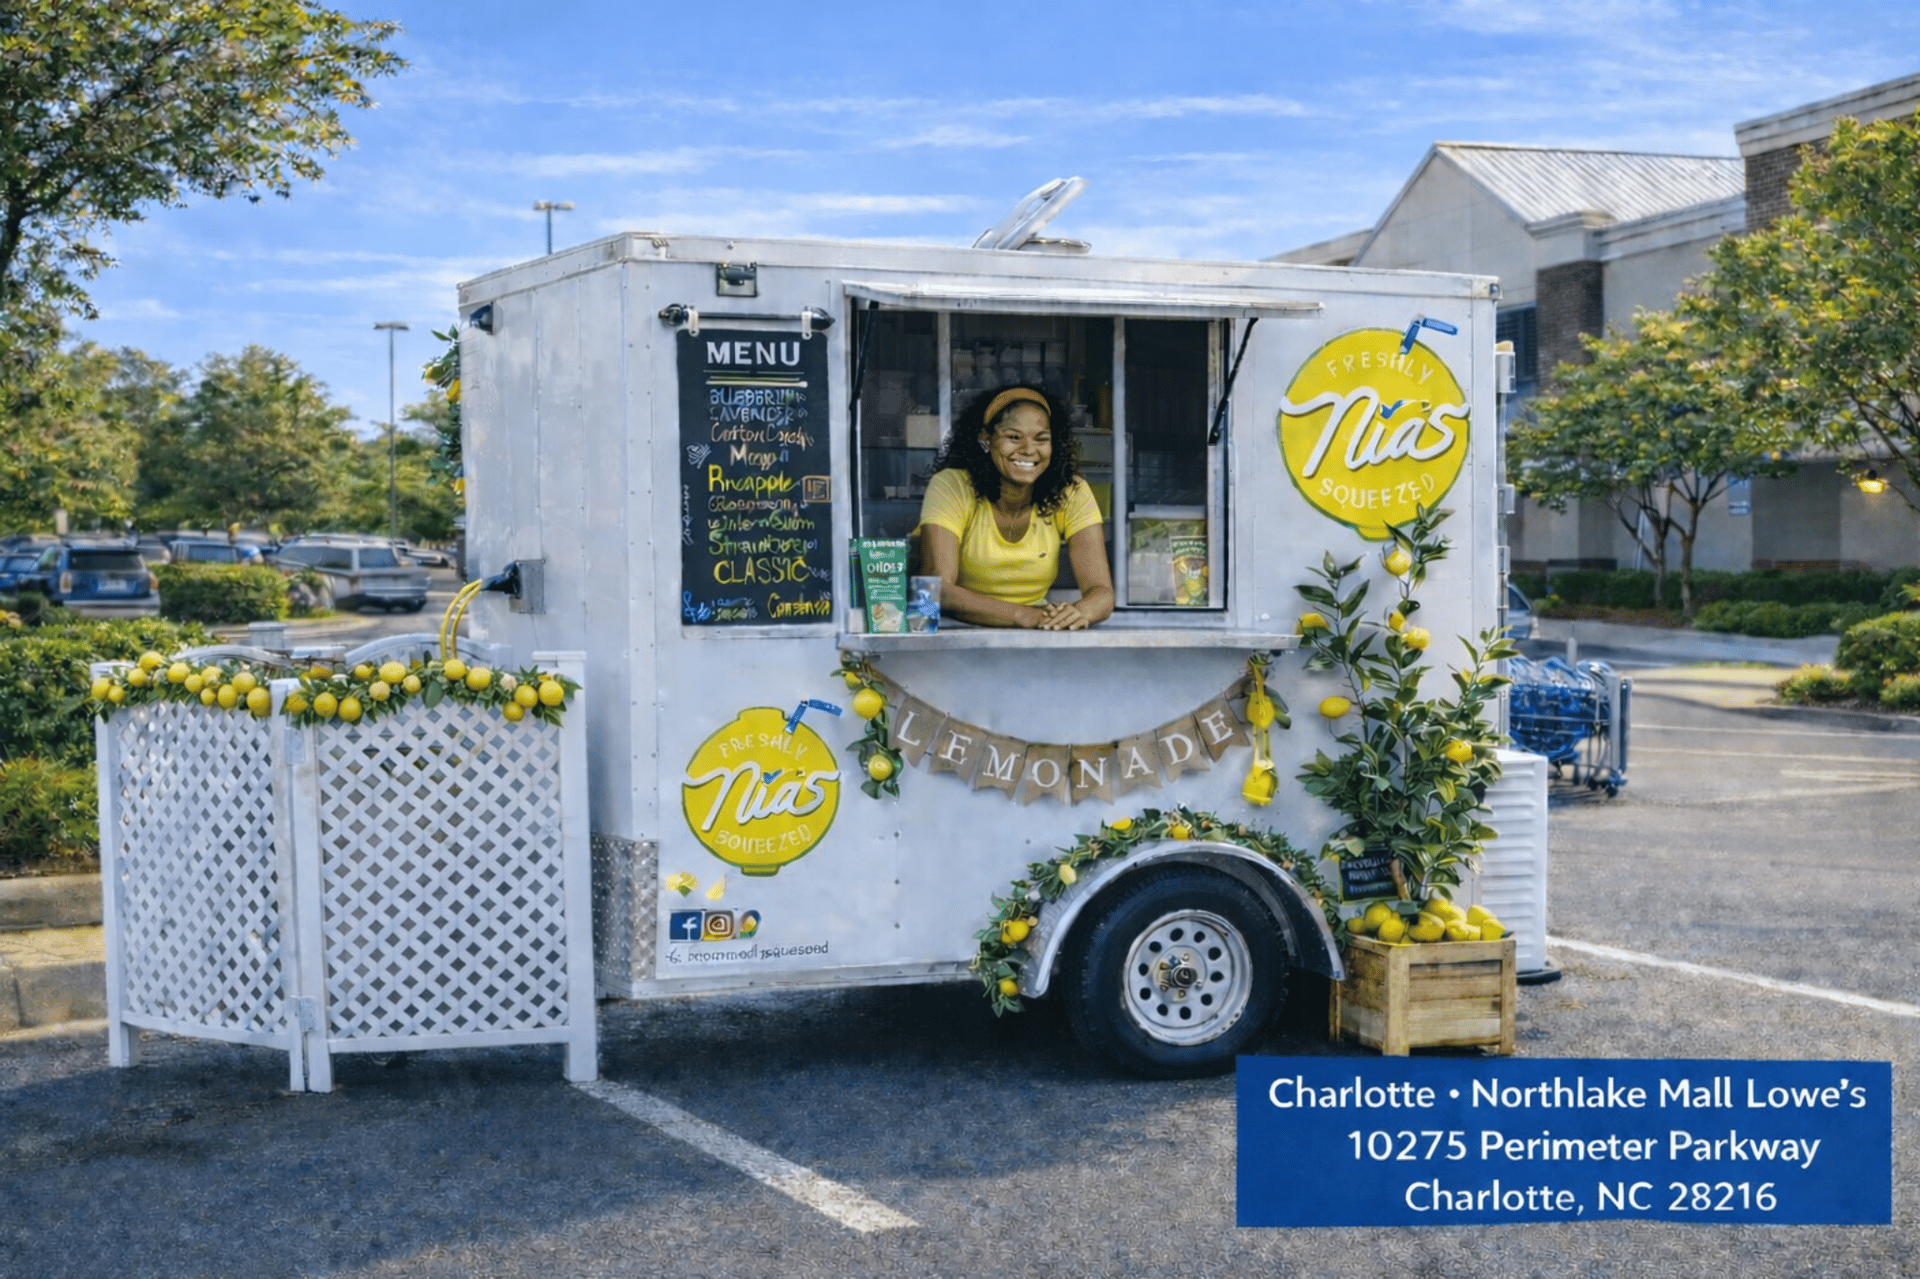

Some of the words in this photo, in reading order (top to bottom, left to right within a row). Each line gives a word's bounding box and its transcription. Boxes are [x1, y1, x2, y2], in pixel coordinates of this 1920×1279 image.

[706, 341, 800, 366] MENU
[1326, 351, 1434, 385] FRESHLY
[1318, 473, 1435, 510] SQUEEZED
[713, 556, 810, 585] CLASSIC
[897, 709, 1235, 789] LEMONADE
